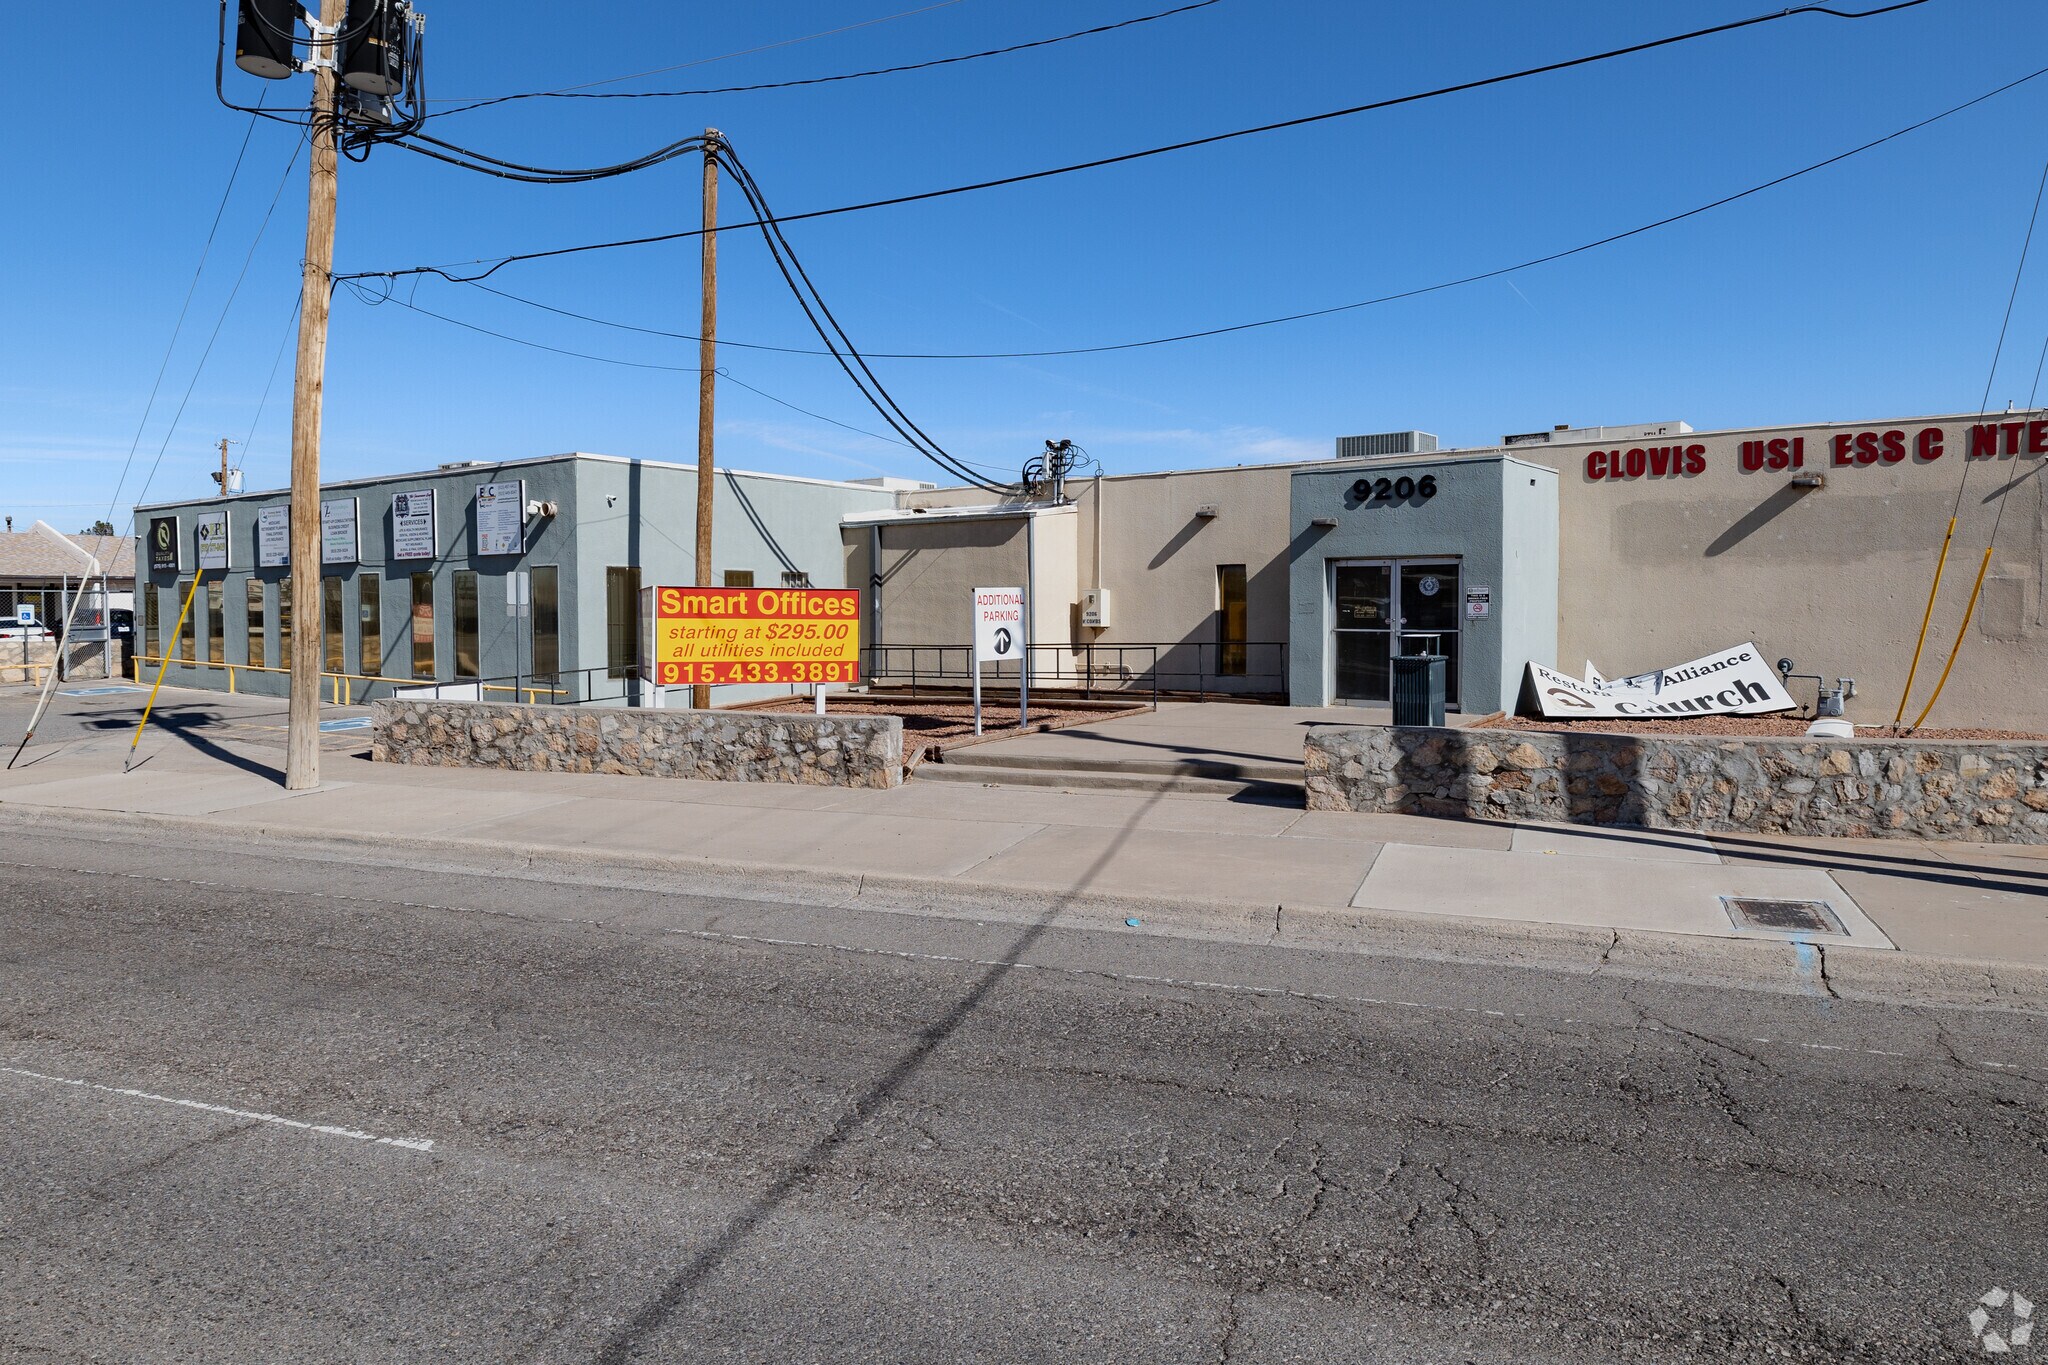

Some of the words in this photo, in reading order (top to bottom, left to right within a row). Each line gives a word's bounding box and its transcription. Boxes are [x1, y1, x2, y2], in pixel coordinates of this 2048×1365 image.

[1587, 444, 1706, 480] CLOVIS
[1353, 474, 1437, 502] 9206
[209, 522, 224, 536] EPC
[661, 588, 748, 614] Smart
[757, 590, 856, 616] Offices
[977, 594, 1024, 606] ADDITIONAL
[983, 610, 1019, 622] PARKING
[668, 625, 738, 643] starting
[744, 626, 762, 639] at
[765, 622, 849, 641] $295.00
[672, 643, 695, 658] all
[700, 643, 764, 657] utilities
[770, 643, 844, 657] included
[663, 662, 854, 684] 915.433.3891
[1664, 652, 1752, 687] Alliance
